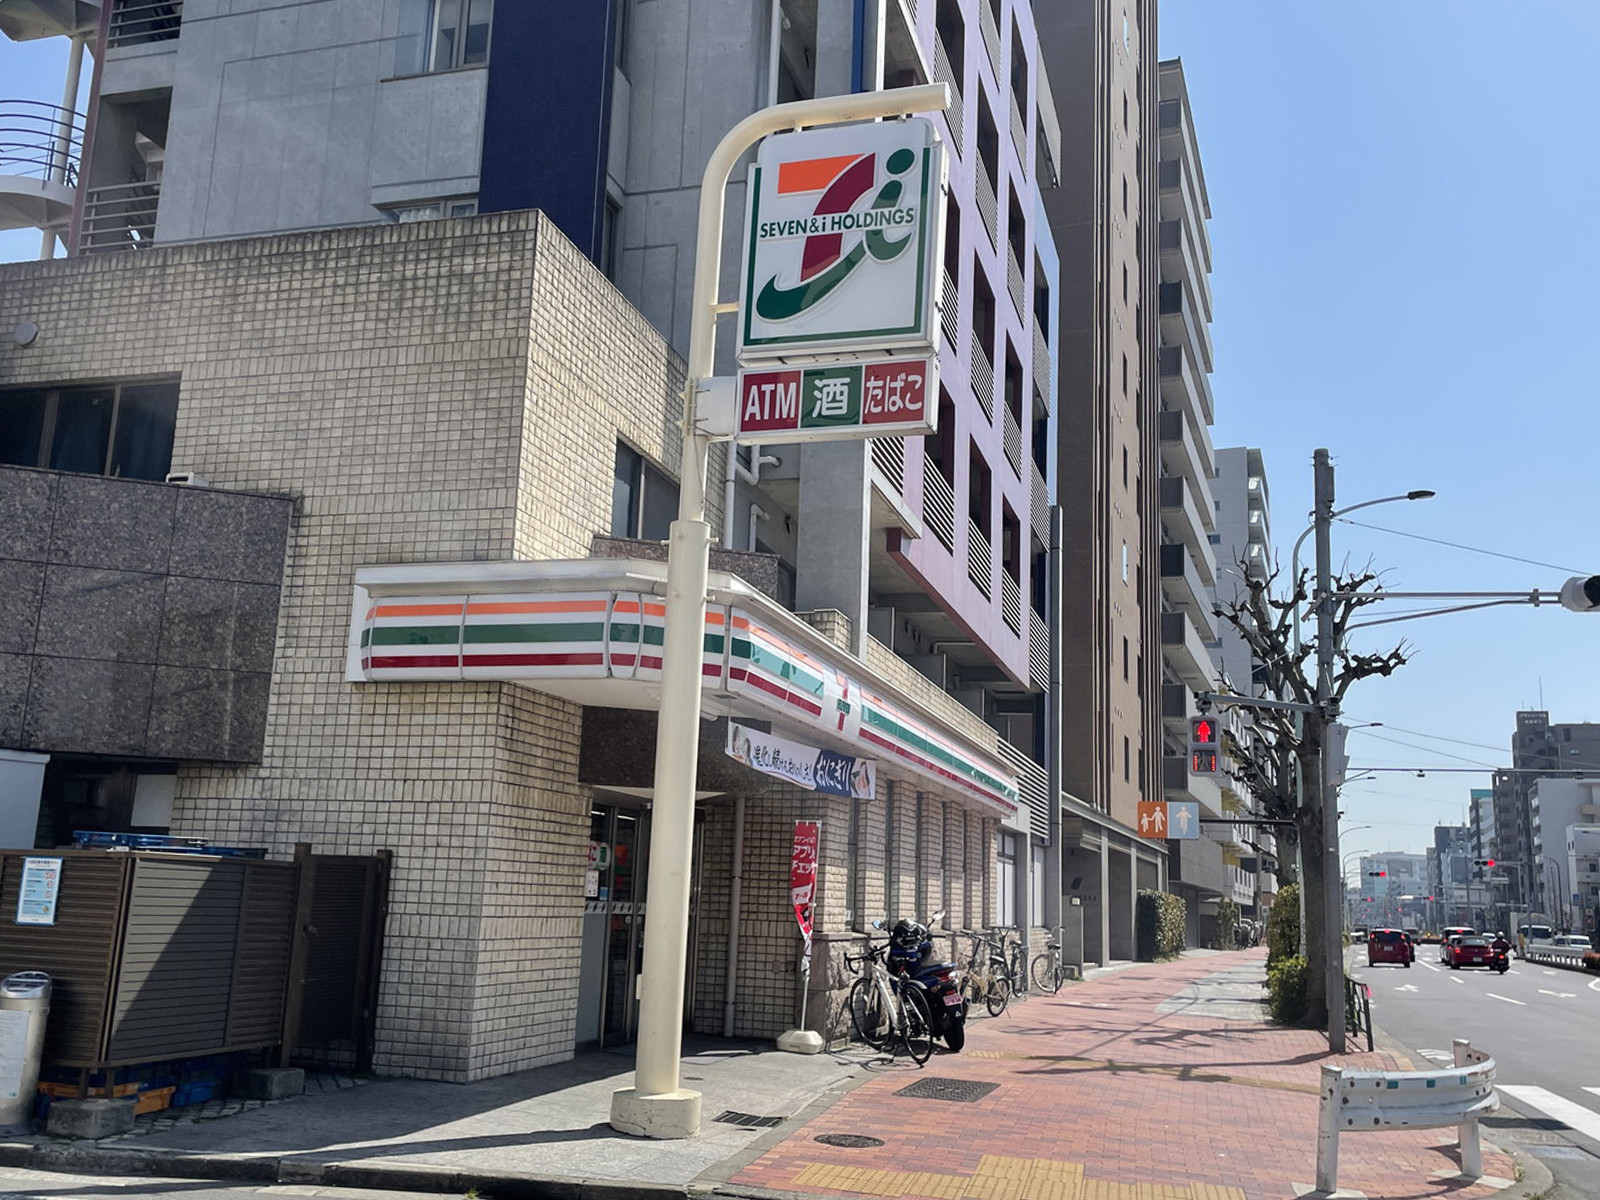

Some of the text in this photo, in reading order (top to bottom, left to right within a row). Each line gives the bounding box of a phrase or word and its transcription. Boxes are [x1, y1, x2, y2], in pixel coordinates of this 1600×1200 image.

[831, 208, 915, 231] HOLDINGS
[744, 373, 923, 421] ATM 酒 たばこ
[816, 755, 852, 791] おにぎり
